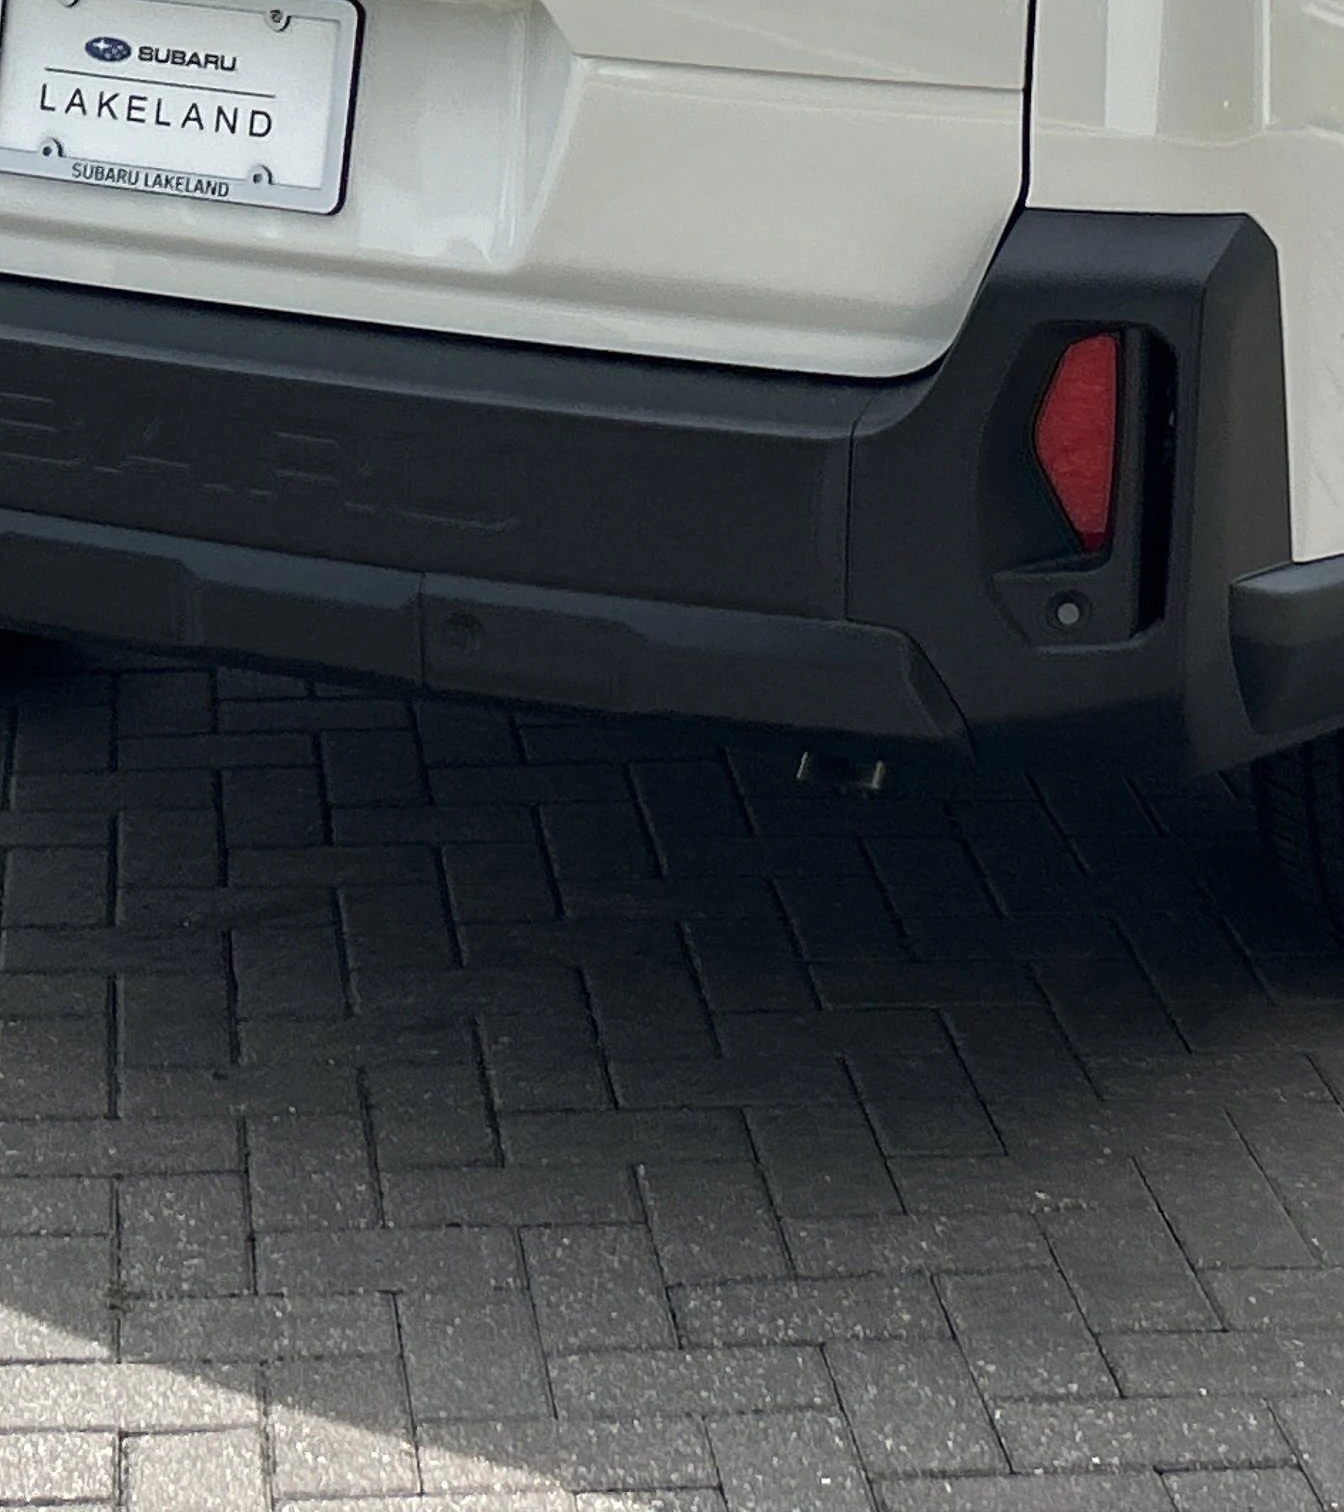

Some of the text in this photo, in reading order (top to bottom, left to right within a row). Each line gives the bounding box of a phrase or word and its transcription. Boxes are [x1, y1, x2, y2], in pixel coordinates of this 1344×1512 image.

[137, 45, 238, 72] SUBARU
[39, 83, 273, 138] LAKELAND
[71, 162, 230, 198] SUBARU LAKELAND
